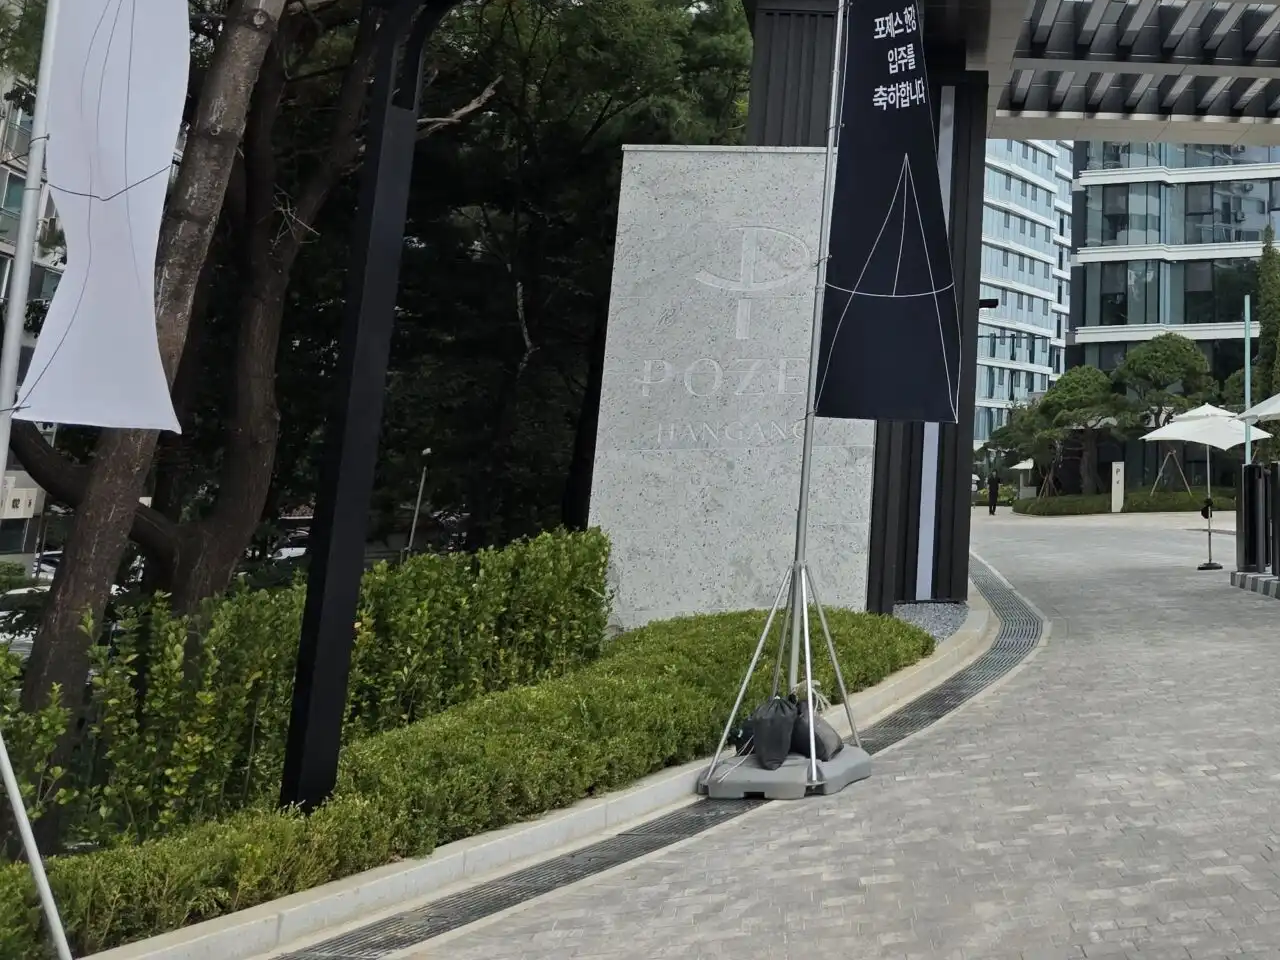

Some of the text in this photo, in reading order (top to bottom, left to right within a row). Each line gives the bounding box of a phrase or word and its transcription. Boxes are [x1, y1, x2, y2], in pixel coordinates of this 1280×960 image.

[873, 3, 917, 39] 포제스 한강
[887, 43, 916, 74] 입주를
[873, 77, 926, 111] 축하합니다
[634, 357, 806, 397] POZE
